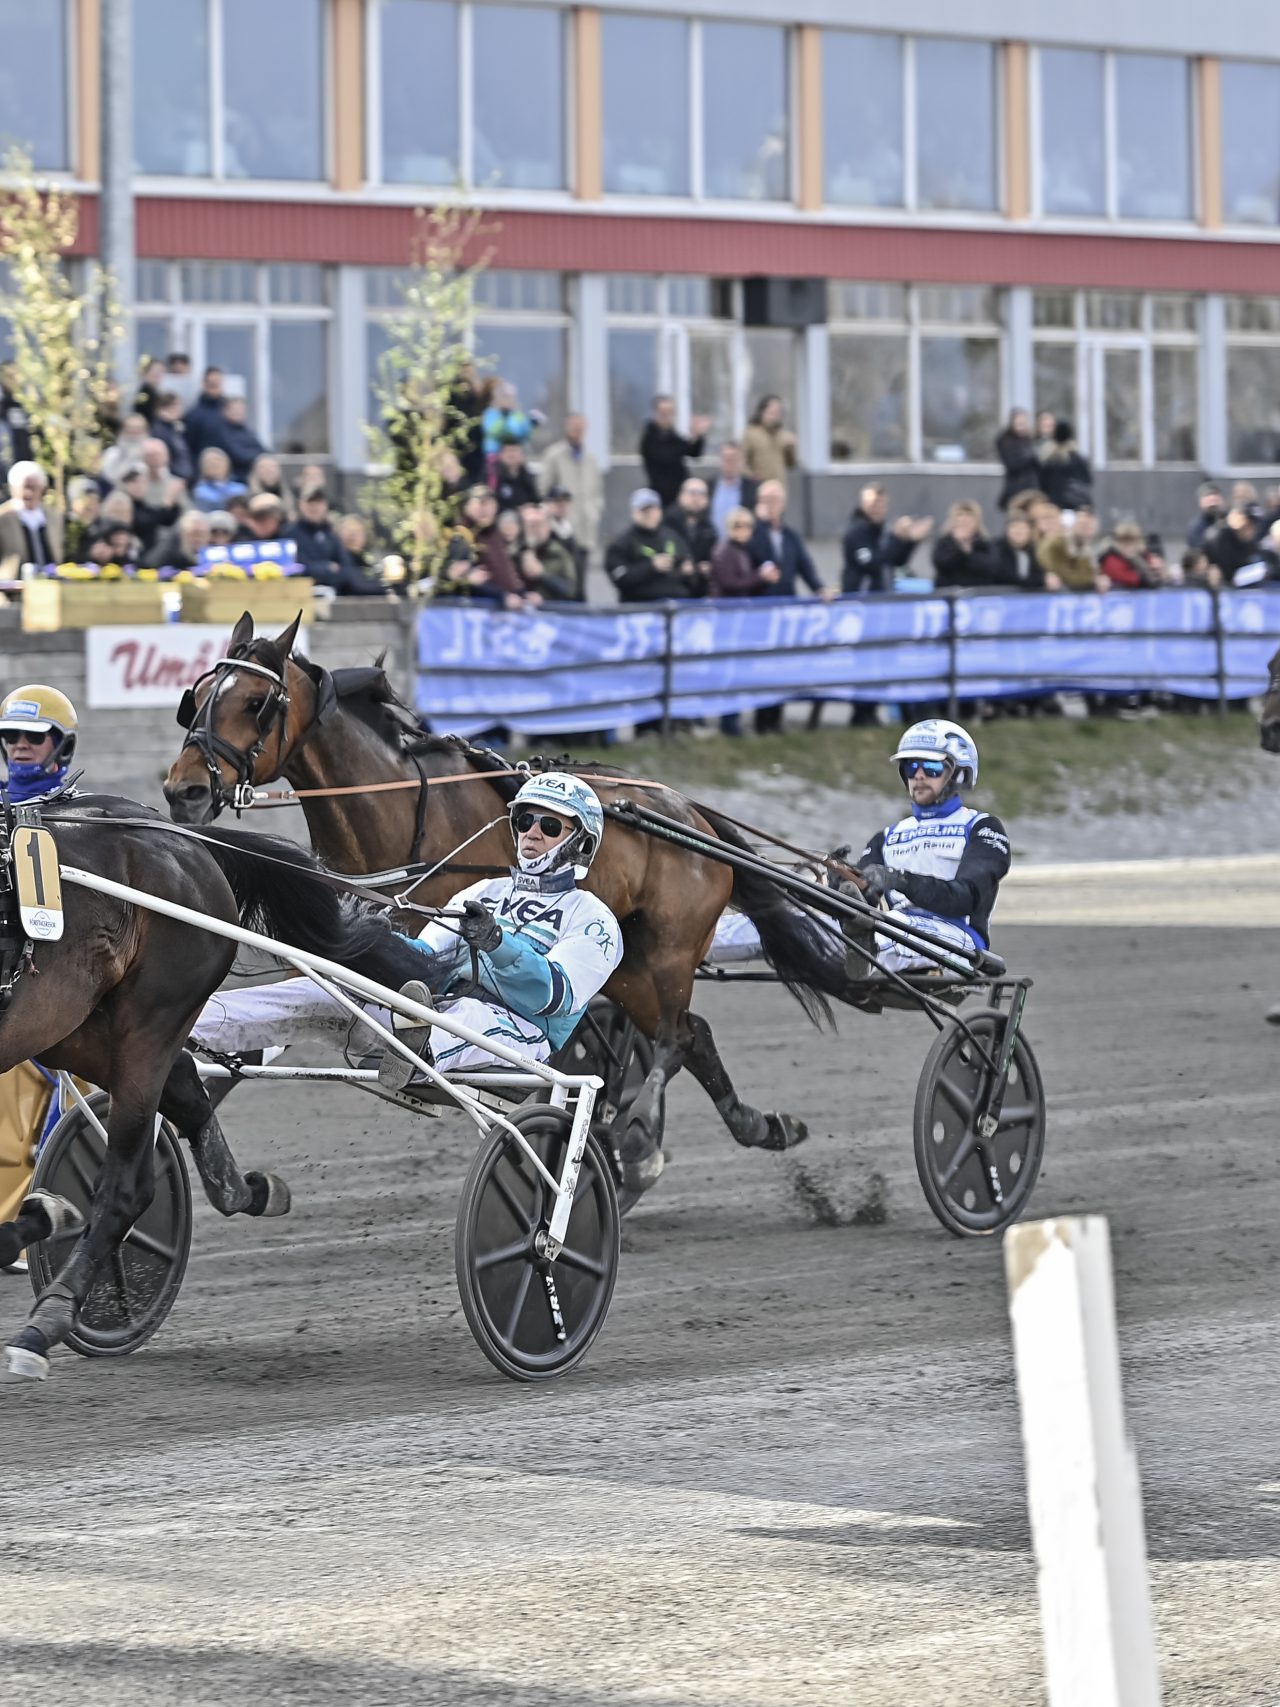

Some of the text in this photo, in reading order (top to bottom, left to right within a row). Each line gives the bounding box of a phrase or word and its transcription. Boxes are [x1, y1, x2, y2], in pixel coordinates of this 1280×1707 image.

[110, 638, 232, 689] Umå
[26, 831, 46, 906] 1
[517, 876, 536, 886] SVEA
